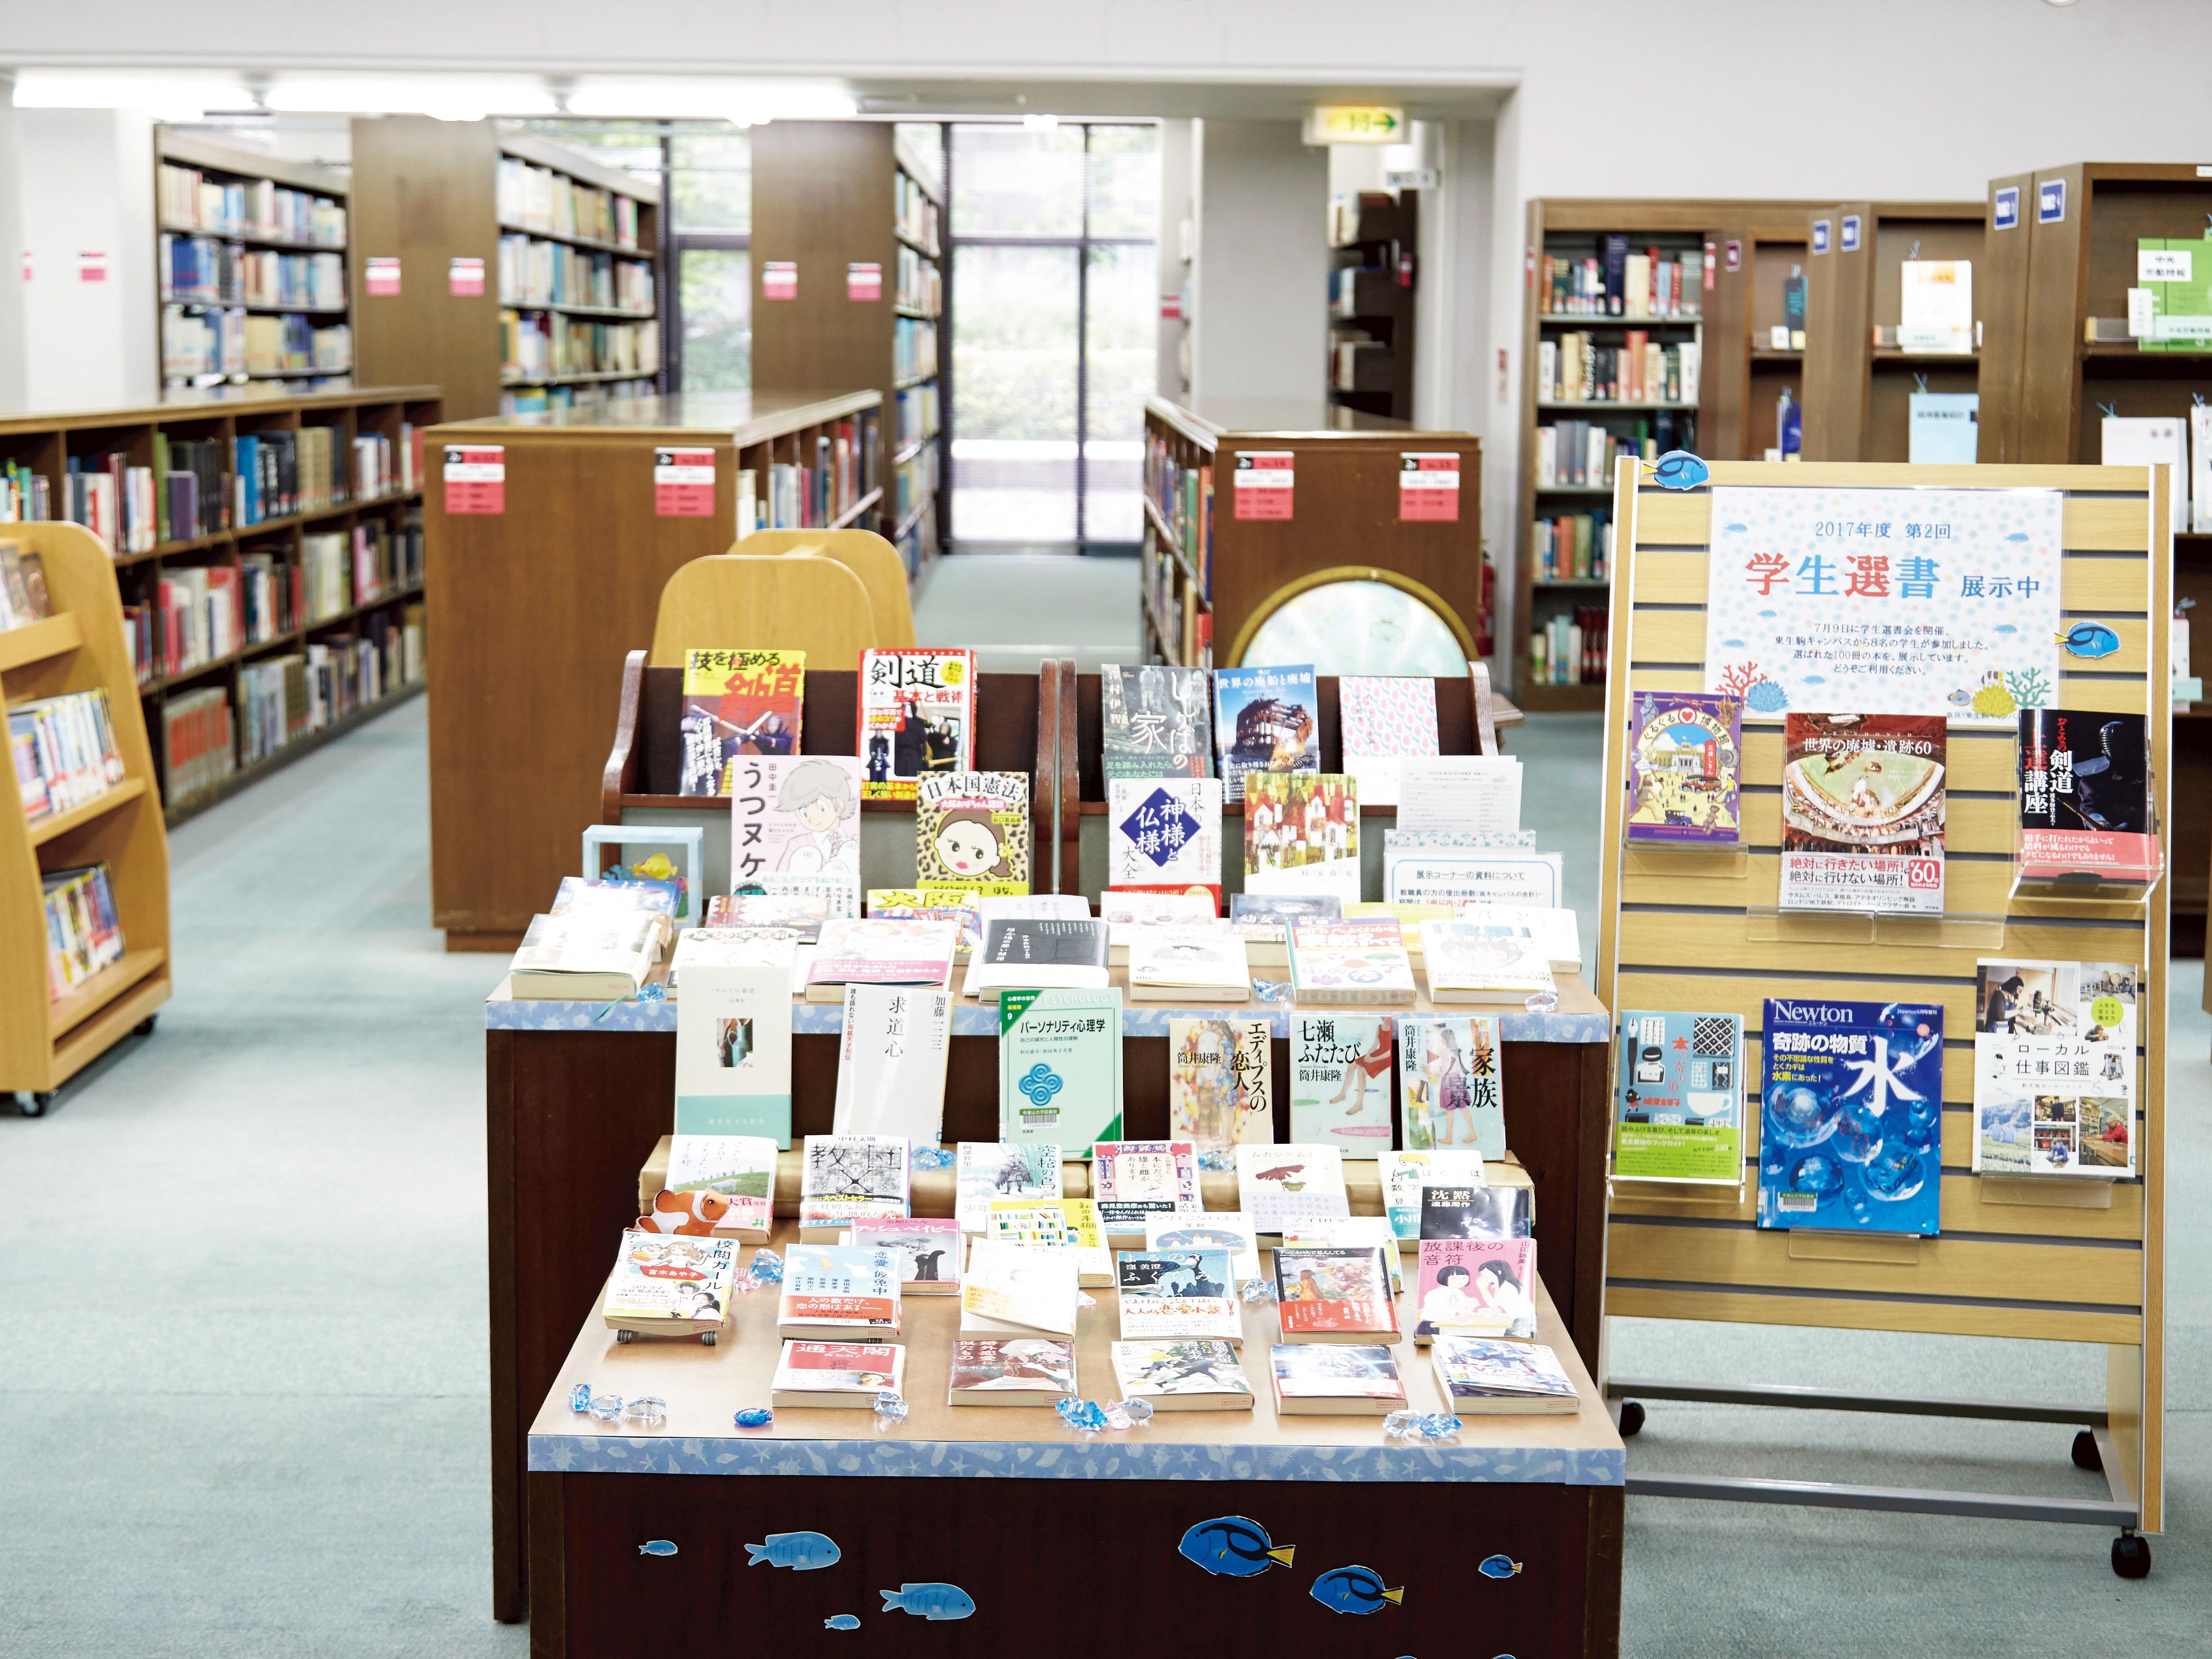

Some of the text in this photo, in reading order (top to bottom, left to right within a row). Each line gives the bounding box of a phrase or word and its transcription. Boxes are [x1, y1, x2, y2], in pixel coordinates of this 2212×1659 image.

[1815, 521, 1951, 540] 2017年度 第2回
[1746, 551, 2041, 599] 学生選書 展示中
[1814, 622, 1949, 636] 7月9日に学生選書会を開催、
[690, 651, 781, 671] 技を極める
[1793, 649, 1969, 664] 選ばれた100冊の本を、展示しています。
[870, 655, 946, 689] 剣道
[1832, 663, 1927, 676] どうぞご利用ください。
[1218, 672, 1312, 689] 世界の廃船と廃墟
[893, 690, 964, 704] 基本と戦術
[1130, 710, 1168, 754] 家
[1644, 713, 1730, 746] ぐるぐる 博物館
[1804, 738, 1932, 755] 世界の廃墟・遺跡60
[1106, 761, 1174, 770] 足を踏み入れたら、
[2023, 728, 2048, 815] 上達講座
[927, 775, 1019, 800] 日本国憲法
[1189, 783, 1205, 823] 日本の
[740, 761, 766, 877] うつヌケ
[1160, 796, 1186, 861] 神様と
[1135, 806, 1161, 855] 仏様
[2024, 833, 2114, 844] 相手に打たれたからといって
[1122, 846, 1138, 879] 大全
[1790, 857, 1904, 873] 絶対に行きたい場所!
[1417, 871, 1525, 880] 展示コーナーの資料について
[1789, 870, 1903, 886] 絶対に行けない場所!
[875, 891, 976, 908] 大阪
[1042, 994, 1115, 1005] PSYCHOLOGY
[1773, 1000, 1854, 1023] Newton
[844, 988, 856, 1061] 誰も語れない将棋天才列伝
[885, 996, 908, 1058] 求道心
[931, 995, 946, 1050] 加藤一二三
[1020, 1018, 1106, 1034] パーソナリティ心理学
[1297, 1020, 1335, 1043] 七瀬
[1298, 1042, 1361, 1063] ふたたび
[1405, 1024, 1417, 1072] 筒井康隆
[1772, 1033, 1867, 1055] 奇跡の物質
[2018, 1043, 2090, 1056] ローカル
[1177, 1052, 1222, 1065] 筒井康隆
[1248, 1023, 1268, 1113] エディプスの
[1772, 1062, 1805, 1071] とくカギは
[1773, 1055, 1834, 1065] その不思議な性質を
[2015, 1059, 2090, 1077] 仕事図鑑
[1230, 1050, 1251, 1091] 恋人
[1299, 1069, 1342, 1082] 筒井康隆
[1444, 1047, 1471, 1108] 八景
[1469, 1044, 1498, 1109] 家族
[1772, 1072, 1821, 1083] 水素にあった!
[1842, 1037, 1926, 1117] 水
[810, 1143, 903, 1170] 教団
[1037, 1145, 1056, 1191] 空棺の烏
[1127, 1156, 1137, 1180] あります
[1138, 1156, 1150, 1182] 雄と雌が
[1153, 1156, 1163, 1184] 本にだって
[835, 1169, 875, 1194] X
[1431, 1190, 1471, 1201] 沈黙
[1079, 1201, 1097, 1229] 私の本棚
[1423, 1241, 1503, 1252] 放課後の
[1517, 1241, 1531, 1265] 山田詠美
[705, 1240, 734, 1290] 校閲ガール
[1124, 1253, 1186, 1263] よるの
[1423, 1254, 1463, 1266] 音符
[648, 1269, 699, 1278] 宮木あや子
[794, 1276, 803, 1291] 中江有里
[873, 1250, 889, 1296] 恋愛仮免中
[1123, 1271, 1214, 1282] ふくらみ
[806, 1277, 815, 1291] 原田マハ
[808, 1297, 870, 1305] 人の数だけ、
[795, 1343, 891, 1357] 通天閣
[959, 1340, 975, 1361] 似たもの
